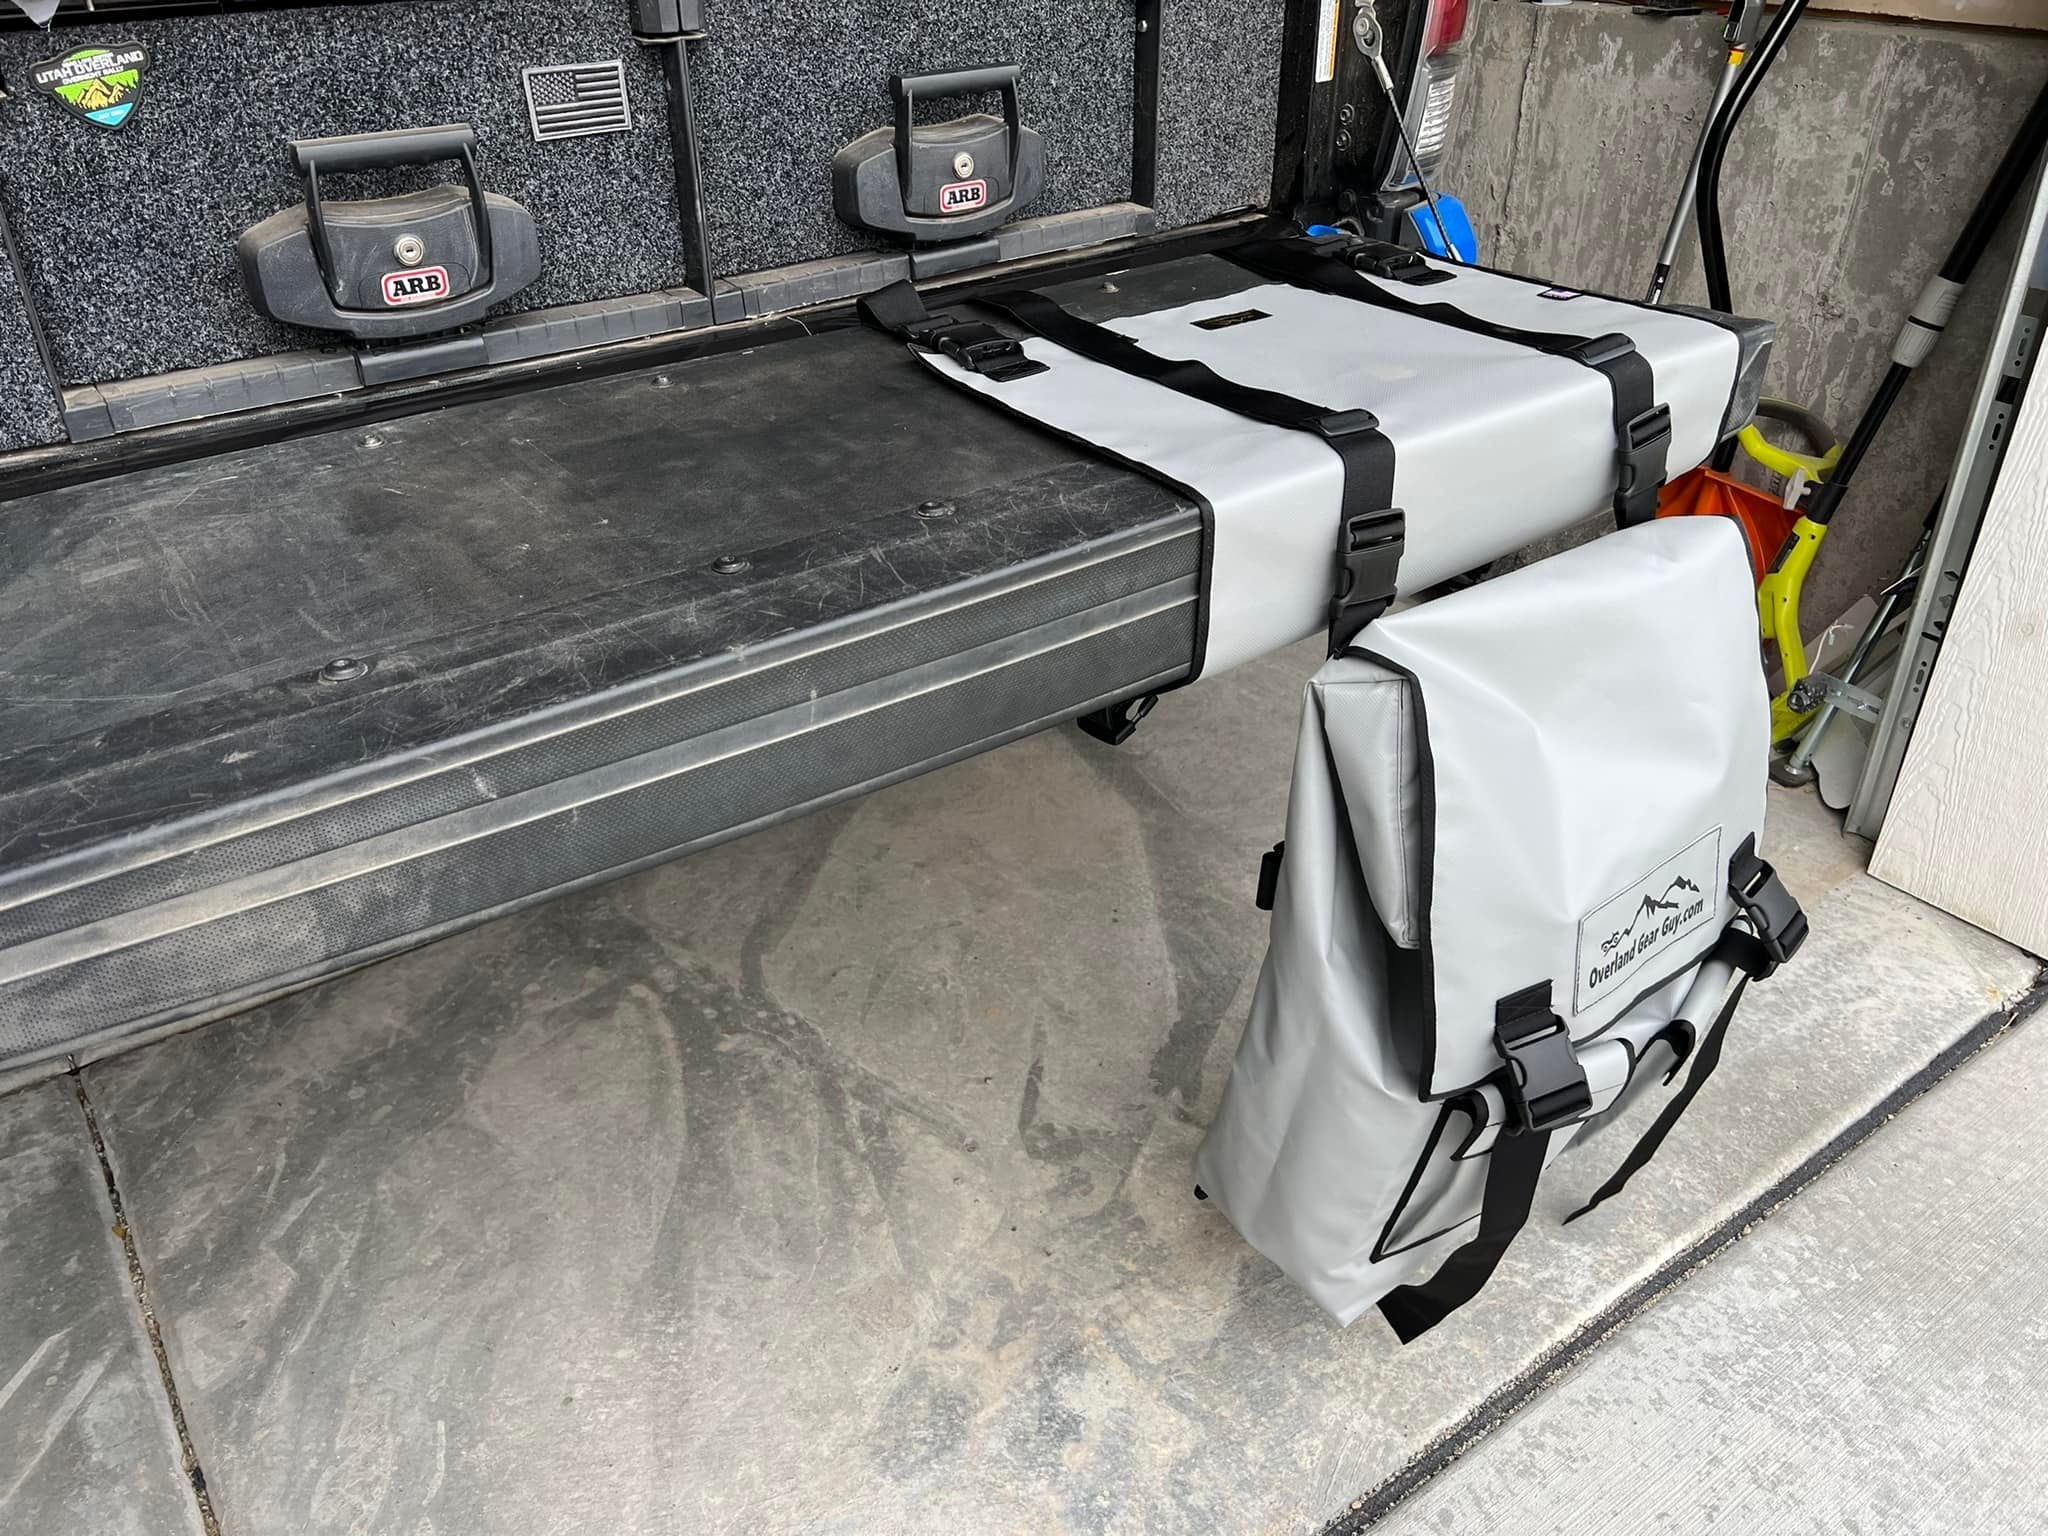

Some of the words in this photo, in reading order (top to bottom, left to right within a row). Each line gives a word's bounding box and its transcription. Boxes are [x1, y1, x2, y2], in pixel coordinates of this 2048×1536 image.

[36, 64, 74, 84] UTAH
[74, 50, 144, 74] OVERLAND
[946, 187, 981, 205] ARB
[393, 275, 441, 297] ARB
[1589, 938, 1637, 989] Overland
[1637, 927, 1660, 954] Gear
[1661, 898, 1704, 936] Guy.com
